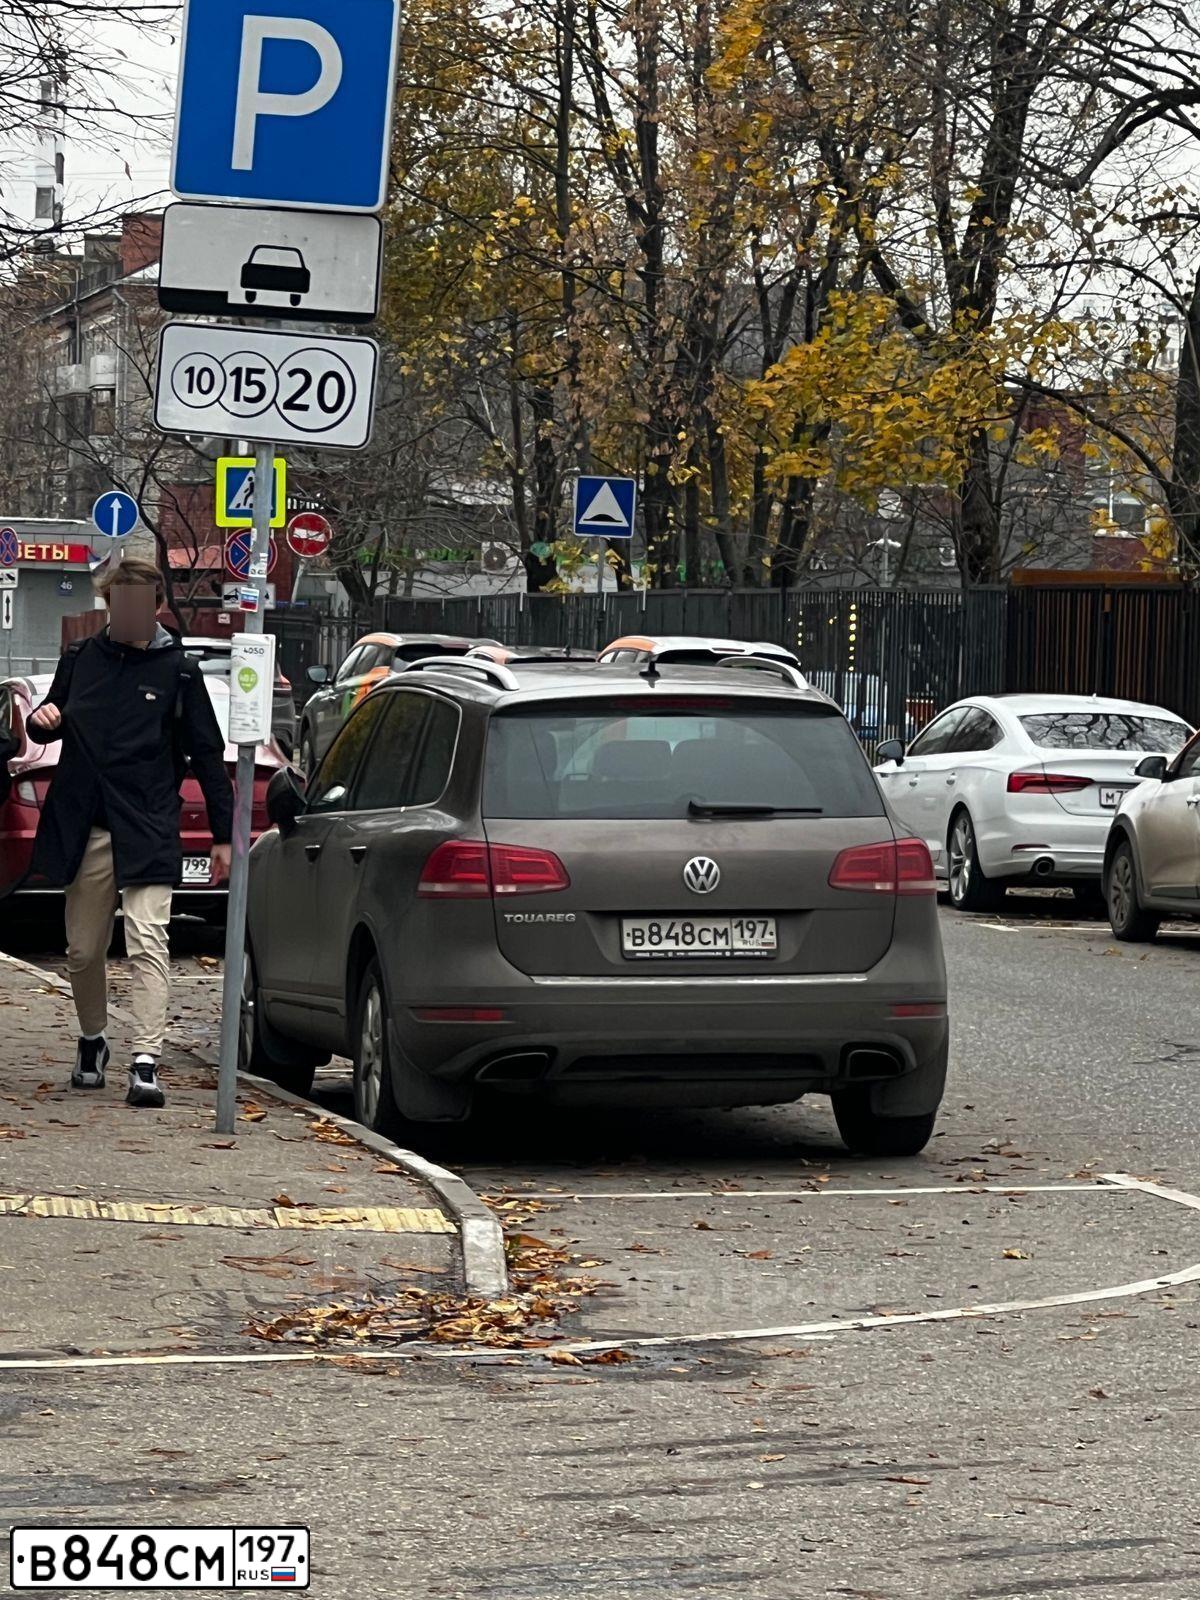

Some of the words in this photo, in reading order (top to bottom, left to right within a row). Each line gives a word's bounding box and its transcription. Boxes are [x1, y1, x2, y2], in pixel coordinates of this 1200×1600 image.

[231, 14, 343, 171] P
[184, 365, 215, 396] 10
[229, 366, 267, 402] 15
[283, 367, 346, 414] 20
[183, 859, 207, 871] 799
[504, 912, 576, 923] TOUAREG
[631, 921, 729, 946] В848СМ
[734, 919, 769, 939] 197
